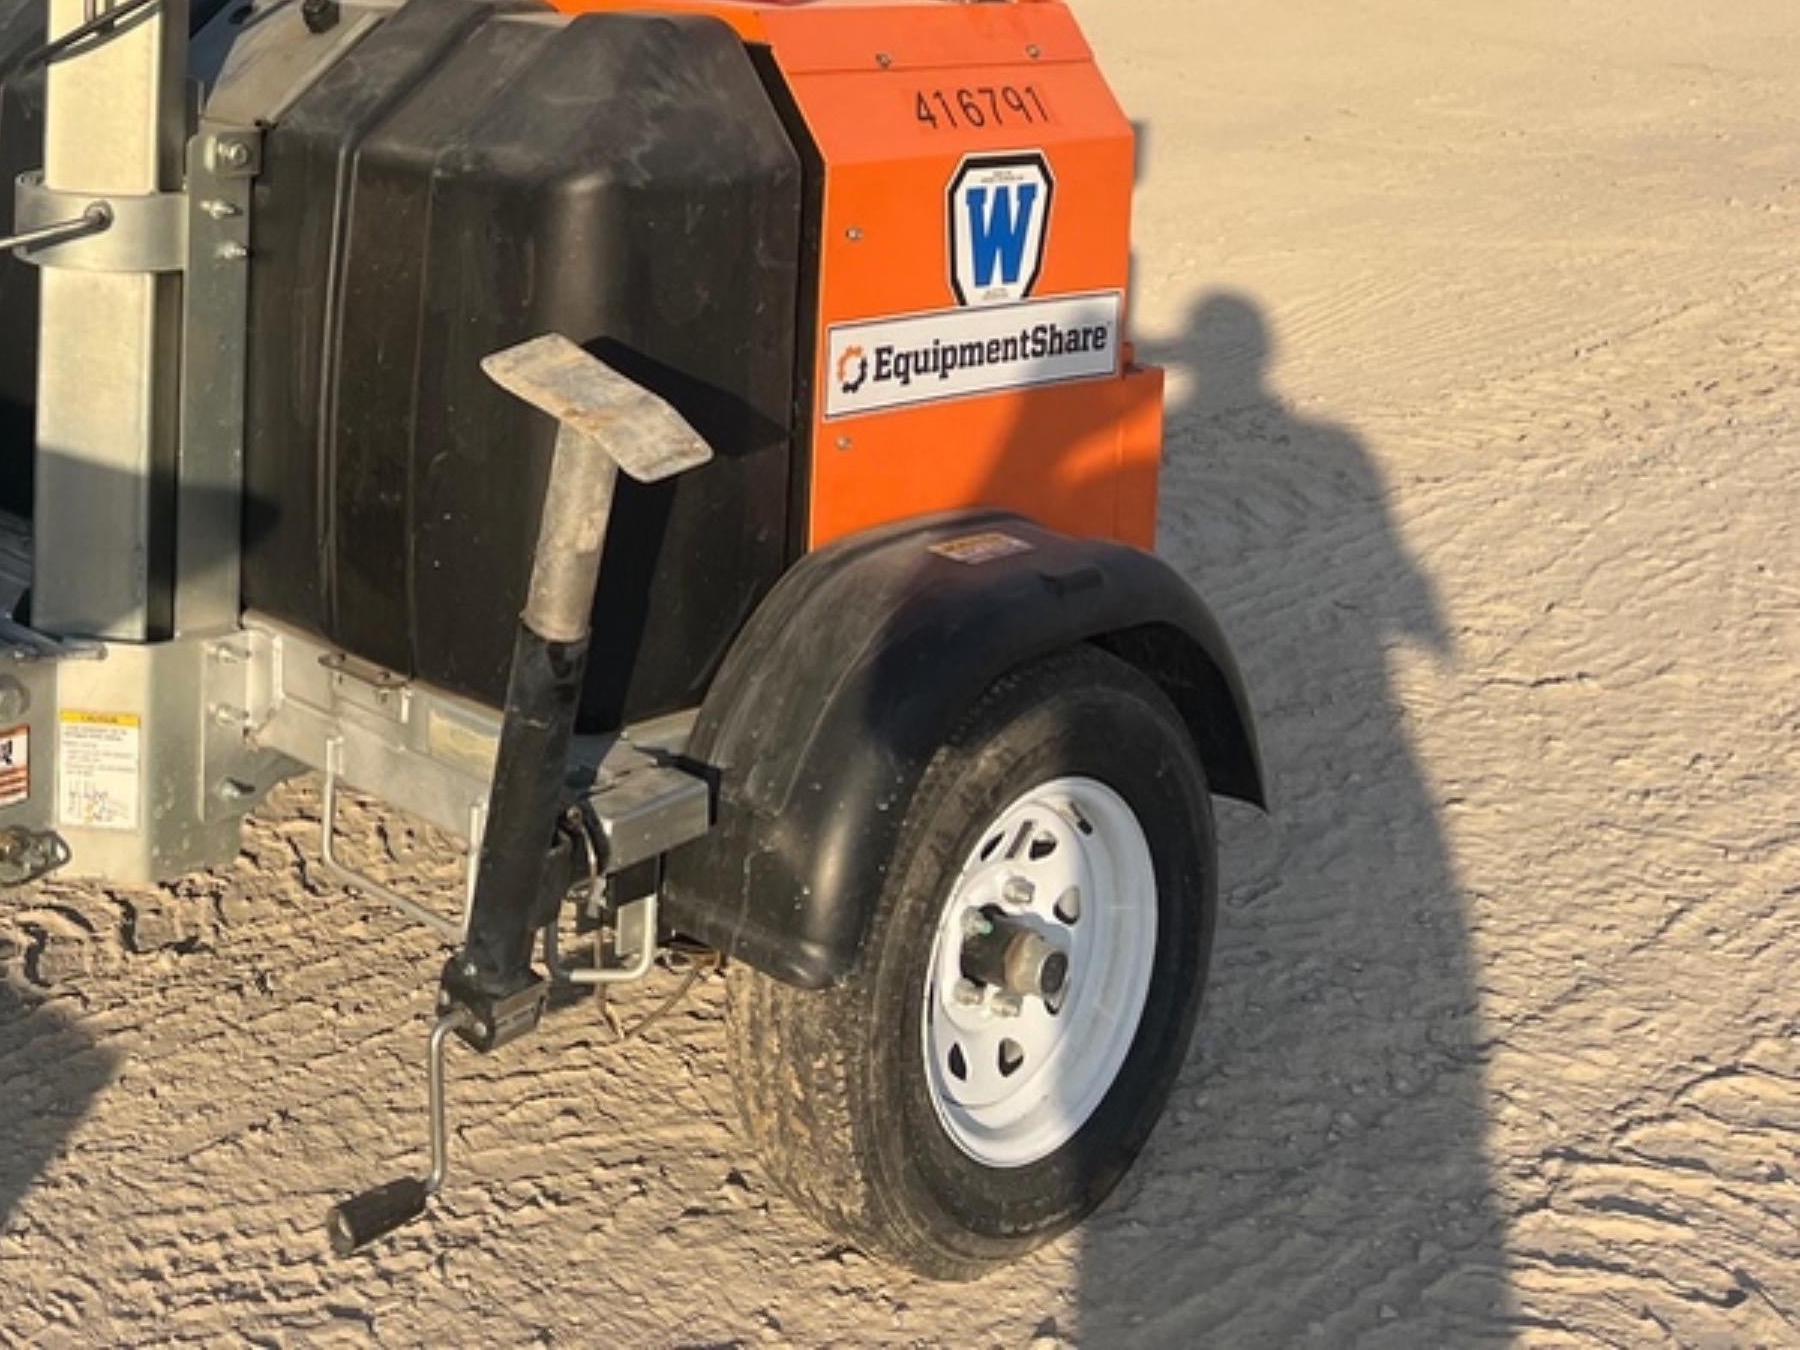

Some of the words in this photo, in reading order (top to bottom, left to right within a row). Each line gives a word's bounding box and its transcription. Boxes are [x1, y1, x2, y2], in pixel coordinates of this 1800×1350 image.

[915, 86, 1049, 130] 416791
[965, 183, 1038, 288] W
[872, 323, 1109, 385] EquipmentShare
